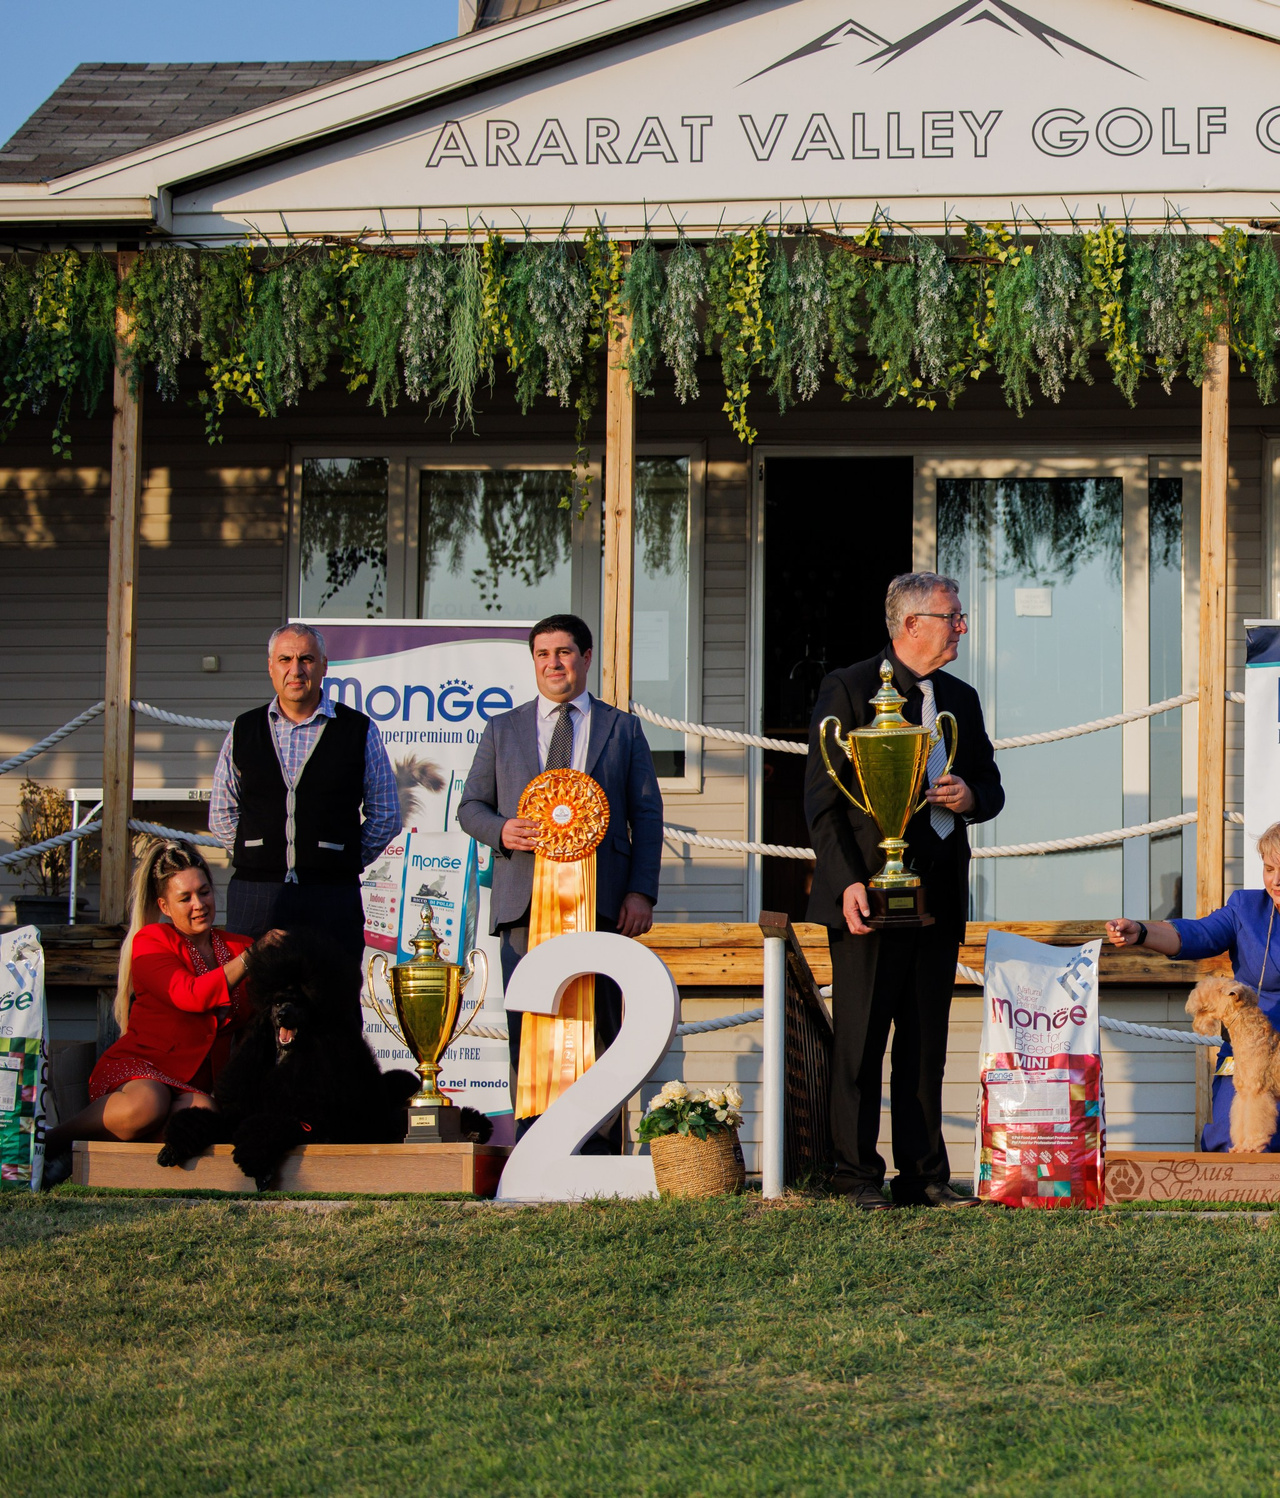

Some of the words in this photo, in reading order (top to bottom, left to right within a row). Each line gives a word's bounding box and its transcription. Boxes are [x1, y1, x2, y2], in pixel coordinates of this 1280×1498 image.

[425, 115, 714, 168] ARARAT
[737, 109, 1003, 162] VALLEY
[1031, 105, 1228, 157] GOLF
[1016, 992, 1039, 1002] Super
[1017, 985, 1043, 997] Natural
[1015, 1026, 1044, 1043] Best
[1047, 1031, 1061, 1043] for
[1014, 1037, 1071, 1054] Breeders
[459, 1047, 481, 1060] FREE
[496, 931, 680, 1201] 2
[1013, 1054, 1049, 1069] MINI
[449, 1078, 466, 1088] nel
[470, 1079, 509, 1089] mondo
